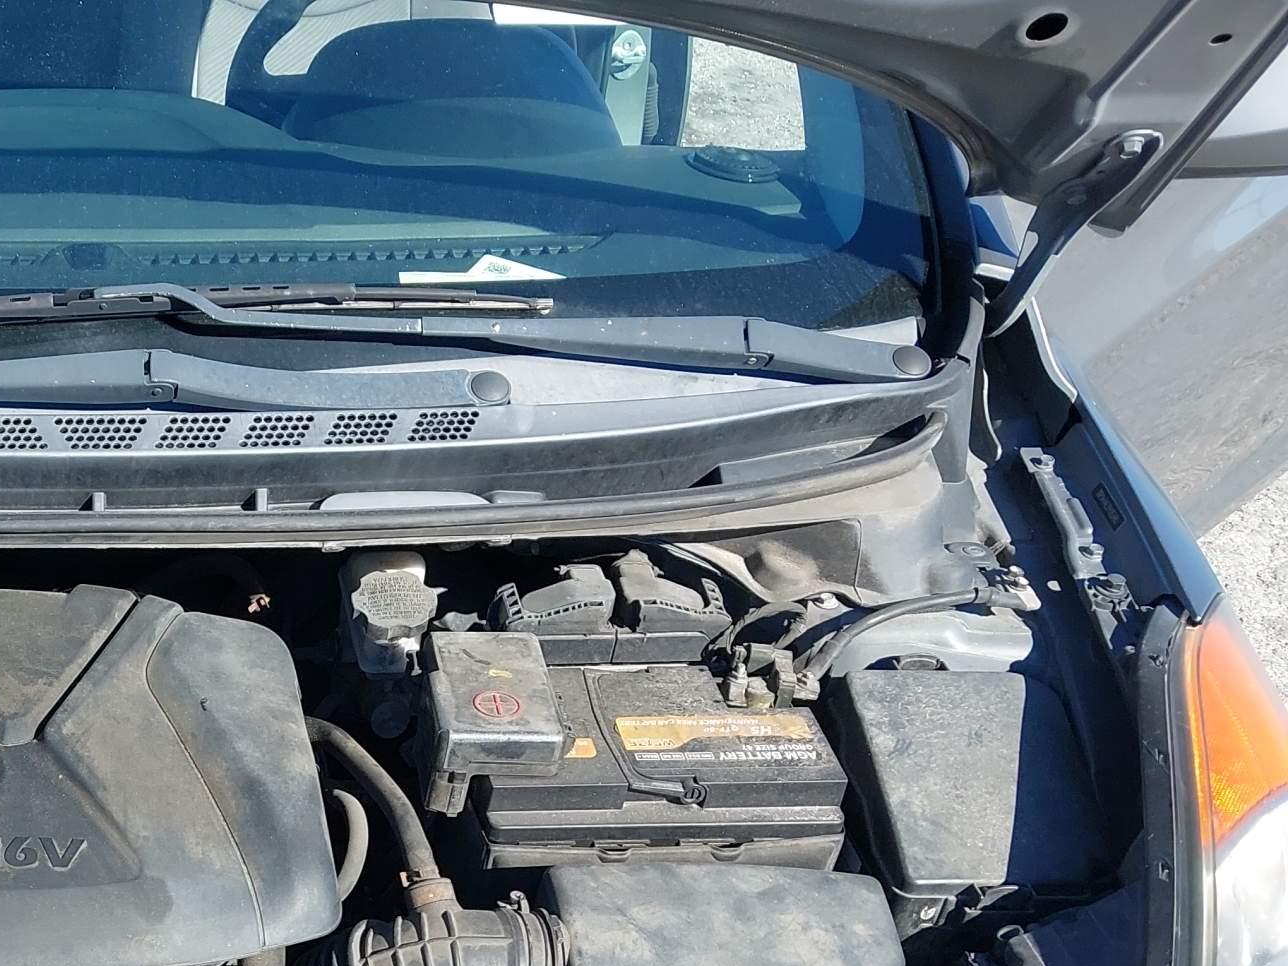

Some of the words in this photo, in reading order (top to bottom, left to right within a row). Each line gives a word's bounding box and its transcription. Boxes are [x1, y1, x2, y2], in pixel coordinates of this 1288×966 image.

[751, 725, 773, 735] H5
[755, 743, 777, 751] SIZE
[777, 743, 813, 751] GROUP
[719, 750, 784, 761] BATTERY
[784, 750, 817, 760] AGM
